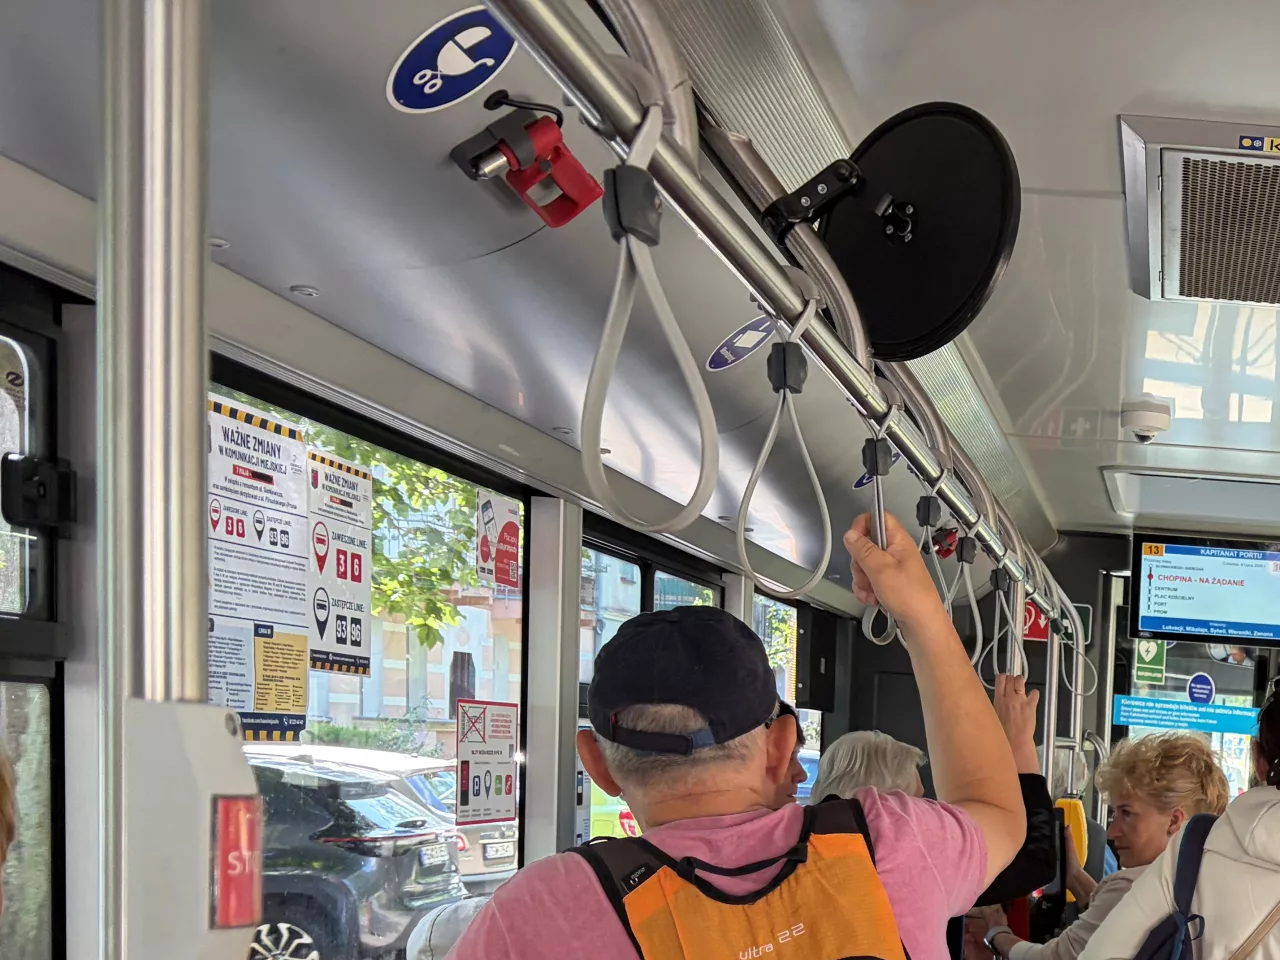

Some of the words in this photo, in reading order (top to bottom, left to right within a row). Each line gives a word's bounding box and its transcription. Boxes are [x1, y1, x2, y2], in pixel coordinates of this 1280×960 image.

[222, 426, 251, 450] WAŻNE
[253, 436, 281, 459] ZMIANY
[218, 445, 224, 455] W
[225, 446, 261, 467] KOMUNIKACJI
[260, 457, 287, 475] MIEJSKIEJ
[324, 471, 341, 487] WAŻNE
[342, 477, 358, 492] ZMIANY
[228, 519, 232, 531] 3
[238, 522, 242, 534] 6
[269, 531, 277, 541] 93
[280, 533, 289, 545] 96
[332, 531, 357, 546] ZAWIESZONE
[357, 536, 367, 549] LINIE:
[1148, 546, 1160, 555] 13
[1200, 548, 1238, 557] KAPITANAT
[1239, 551, 1263, 559] PORTU
[339, 554, 345, 572] 3
[354, 559, 359, 576] 6
[1158, 574, 1193, 582] CHOPINA
[1211, 577, 1245, 587] ŻĄDANIE
[336, 620, 346, 638] 93
[351, 624, 360, 641] 96
[740, 943, 773, 960] ultra
[777, 923, 806, 944] 22
